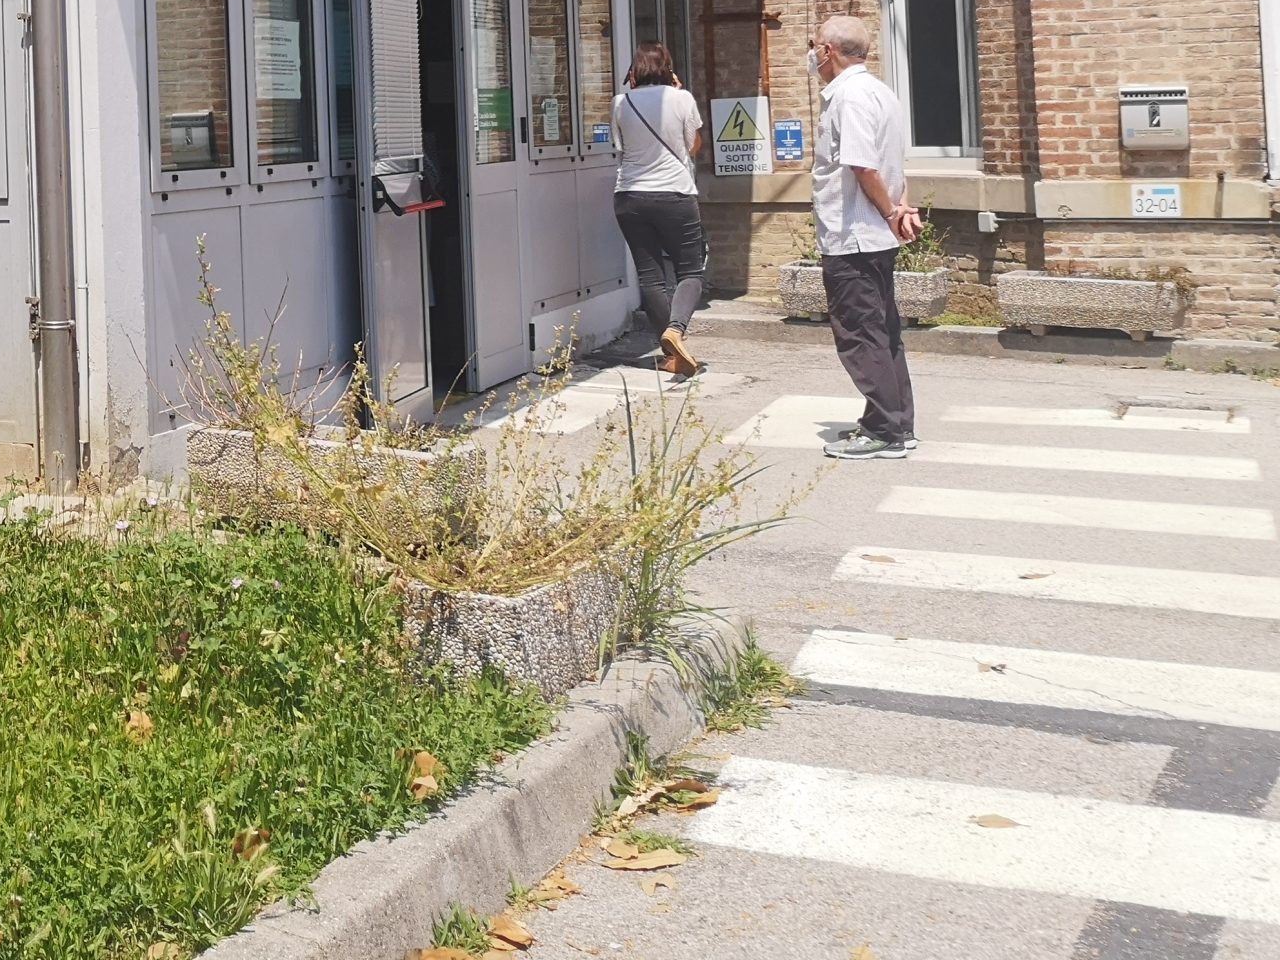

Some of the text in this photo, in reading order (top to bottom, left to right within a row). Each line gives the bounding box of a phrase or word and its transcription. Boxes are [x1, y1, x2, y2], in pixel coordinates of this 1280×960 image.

[721, 144, 762, 152] QUADRO
[726, 154, 758, 162] SOTTO
[718, 164, 767, 172] TENSIONE
[1135, 198, 1178, 213] 32-04
